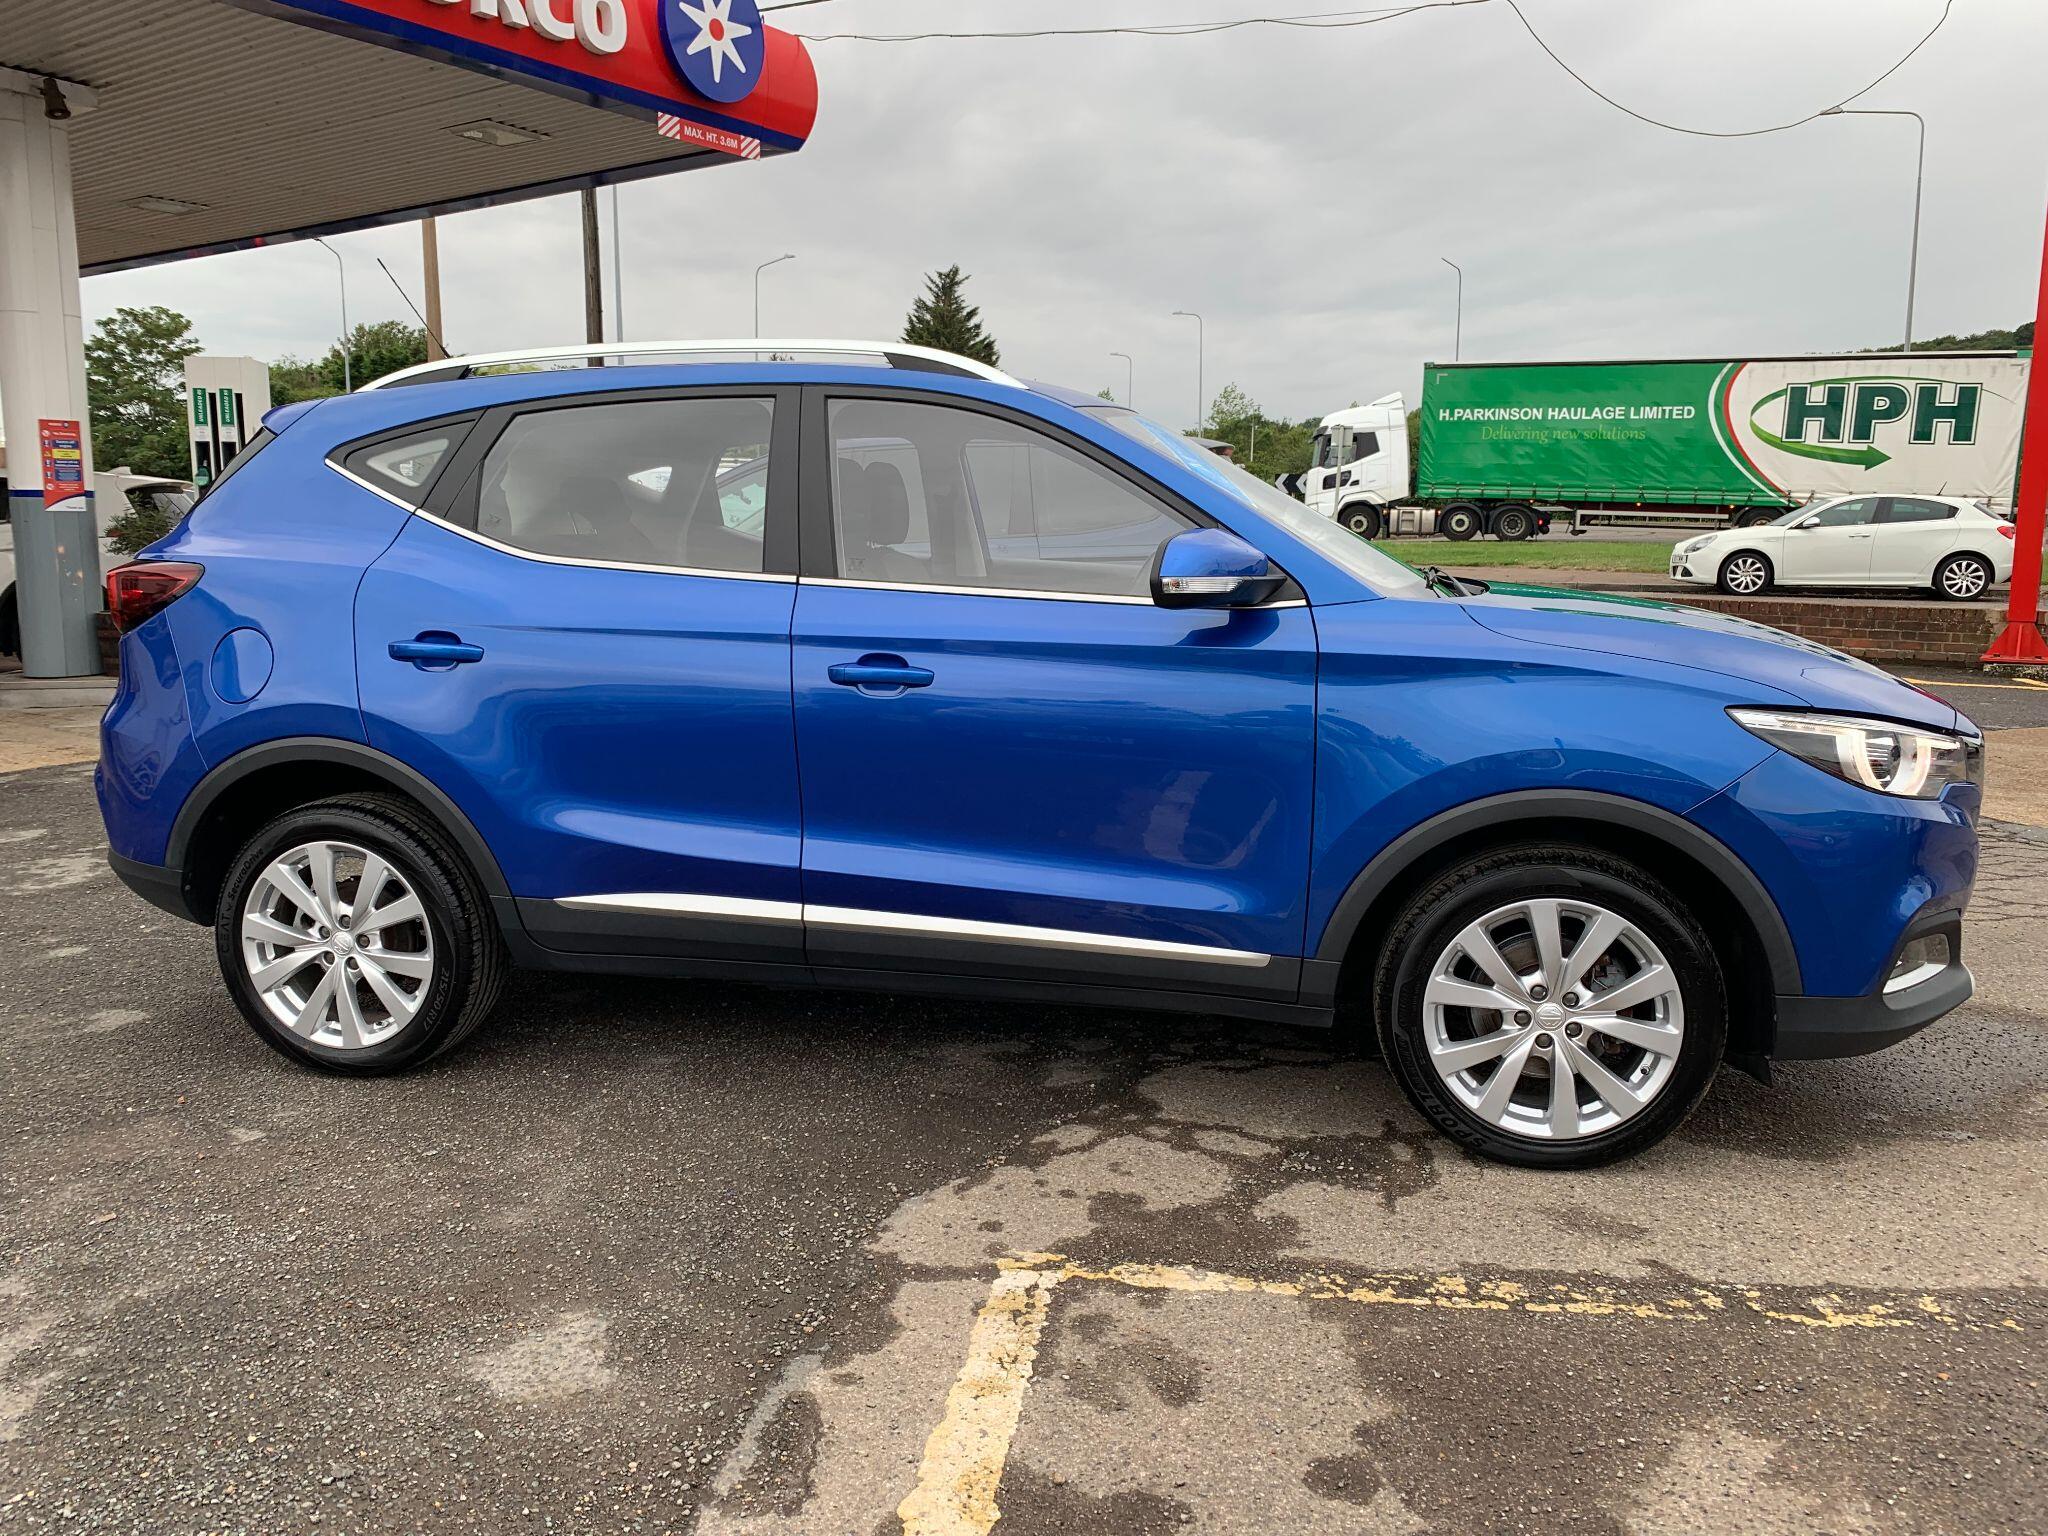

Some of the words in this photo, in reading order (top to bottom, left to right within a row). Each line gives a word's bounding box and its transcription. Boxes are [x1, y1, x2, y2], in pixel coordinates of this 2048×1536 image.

[684, 125, 705, 140] MAX.
[706, 131, 719, 144] HT.
[1438, 407, 1543, 421] H.PARKINSON
[1547, 406, 1626, 420] HAULAGE
[1629, 406, 1696, 419] LIMITED
[1781, 382, 1983, 445] HPH
[1481, 426, 1549, 444] Delivering
[1552, 428, 1580, 440] new
[1583, 426, 1646, 440] solutions
